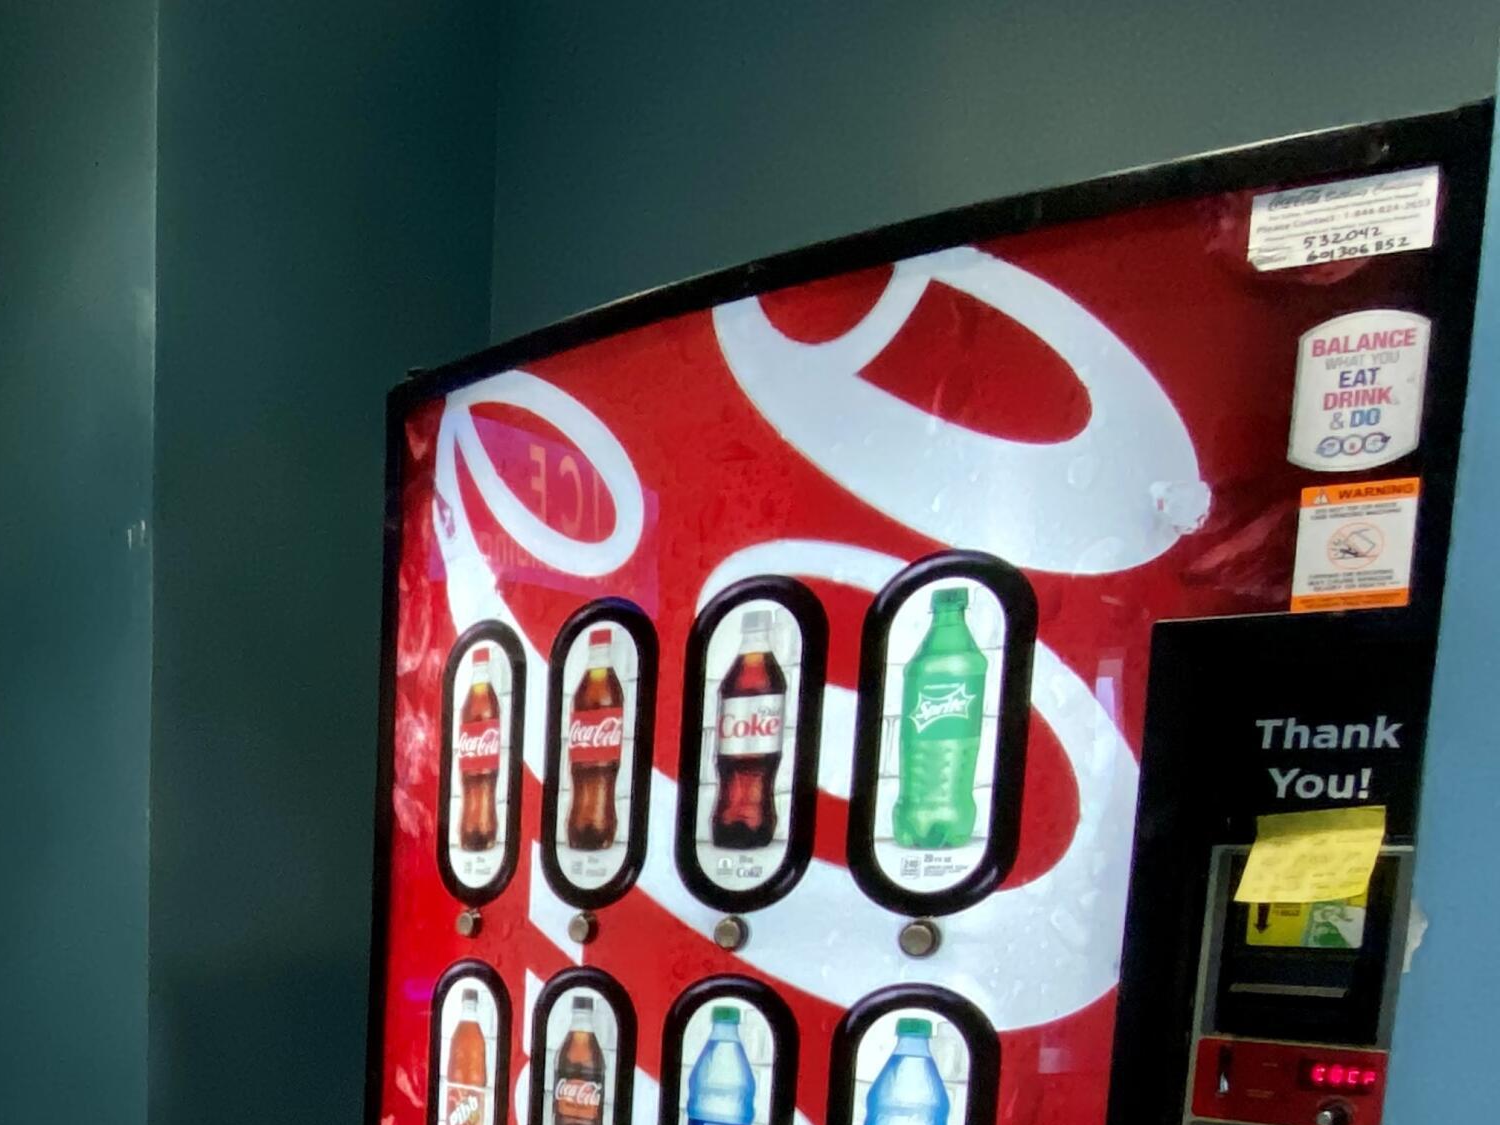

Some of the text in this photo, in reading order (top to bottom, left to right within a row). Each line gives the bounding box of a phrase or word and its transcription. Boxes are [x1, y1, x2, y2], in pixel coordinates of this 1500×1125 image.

[1312, 328, 1417, 357] BALANCE
[1325, 352, 1400, 371] WHAT YOU
[1339, 367, 1380, 389] EAT
[1323, 386, 1393, 411] DRINK
[1330, 408, 1380, 430] & DO
[1338, 482, 1416, 500] WARNING
[718, 713, 780, 740] Coke
[1255, 715, 1403, 750] Thank
[1267, 767, 1373, 799] You!
